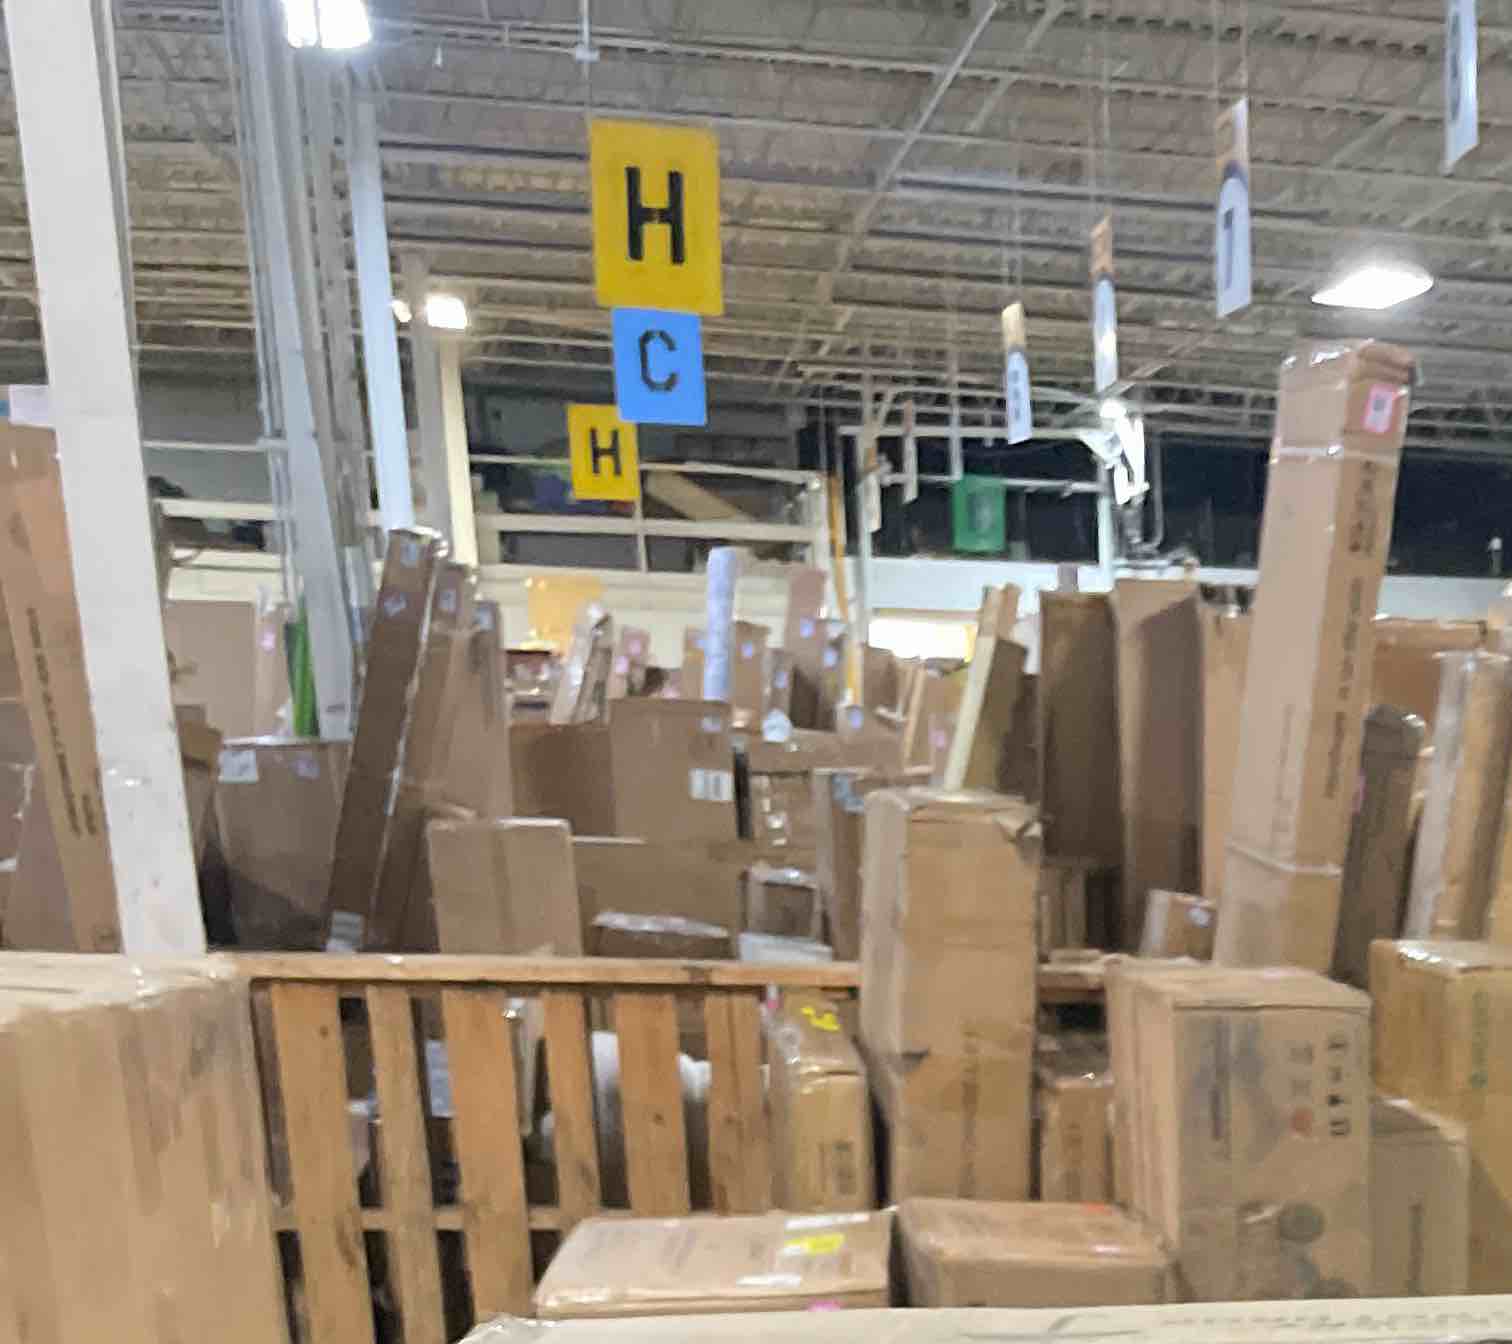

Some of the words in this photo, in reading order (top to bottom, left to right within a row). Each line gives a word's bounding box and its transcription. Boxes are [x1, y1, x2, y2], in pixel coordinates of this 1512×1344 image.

[626, 165, 685, 265] H
[638, 329, 678, 392] C
[589, 426, 622, 477] H
